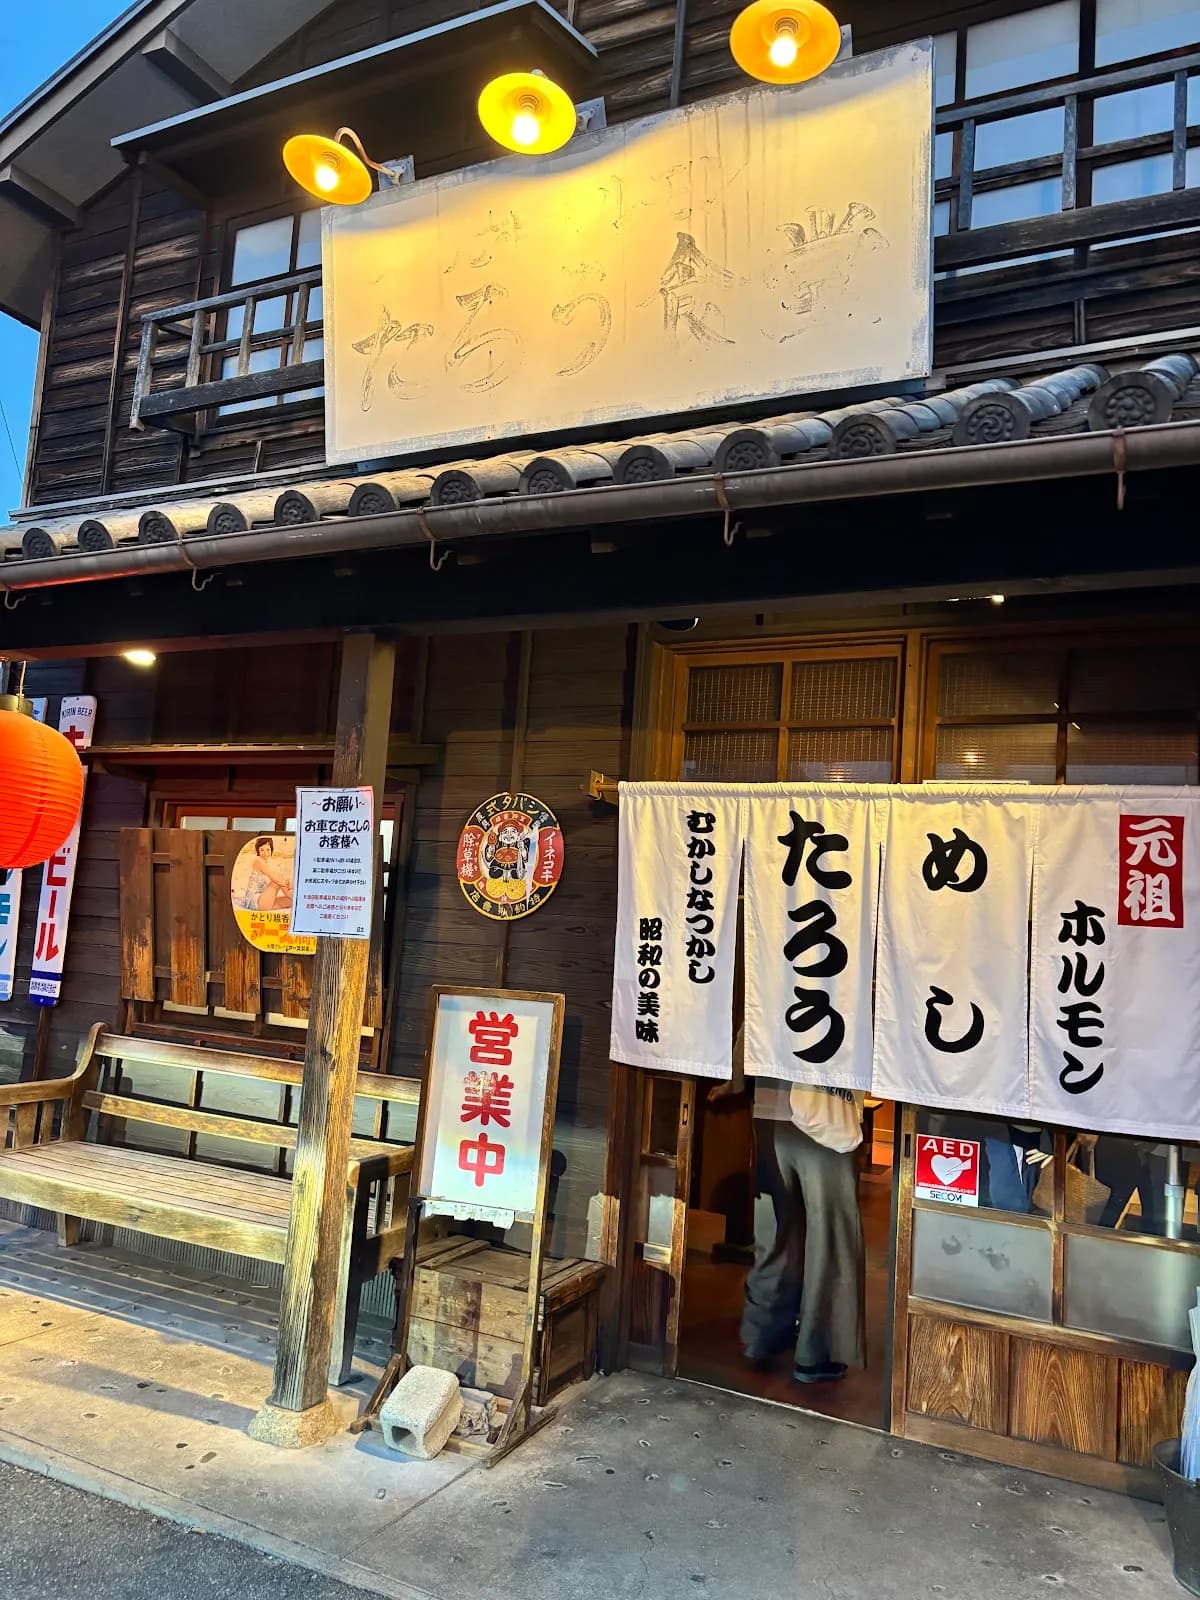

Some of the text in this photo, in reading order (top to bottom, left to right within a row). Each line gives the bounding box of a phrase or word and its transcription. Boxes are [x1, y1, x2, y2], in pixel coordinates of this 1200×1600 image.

[61, 705, 93, 719] KIRIN BEER
[304, 820, 370, 833] お車でおこしの
[319, 835, 360, 849] お客様へ
[541, 831, 556, 882] イネコキ
[1123, 817, 1176, 921] 元祖
[36, 847, 70, 962] ビール
[685, 810, 716, 984] むかしなつかし
[777, 810, 852, 1063] たろう
[922, 827, 988, 1053] めし
[635, 917, 662, 1043] 昭和の美味
[1056, 899, 1105, 1094] ホルモン
[458, 1010, 518, 1187] 営業中
[922, 1138, 974, 1157] AED
[930, 1190, 963, 1203] SECOM
